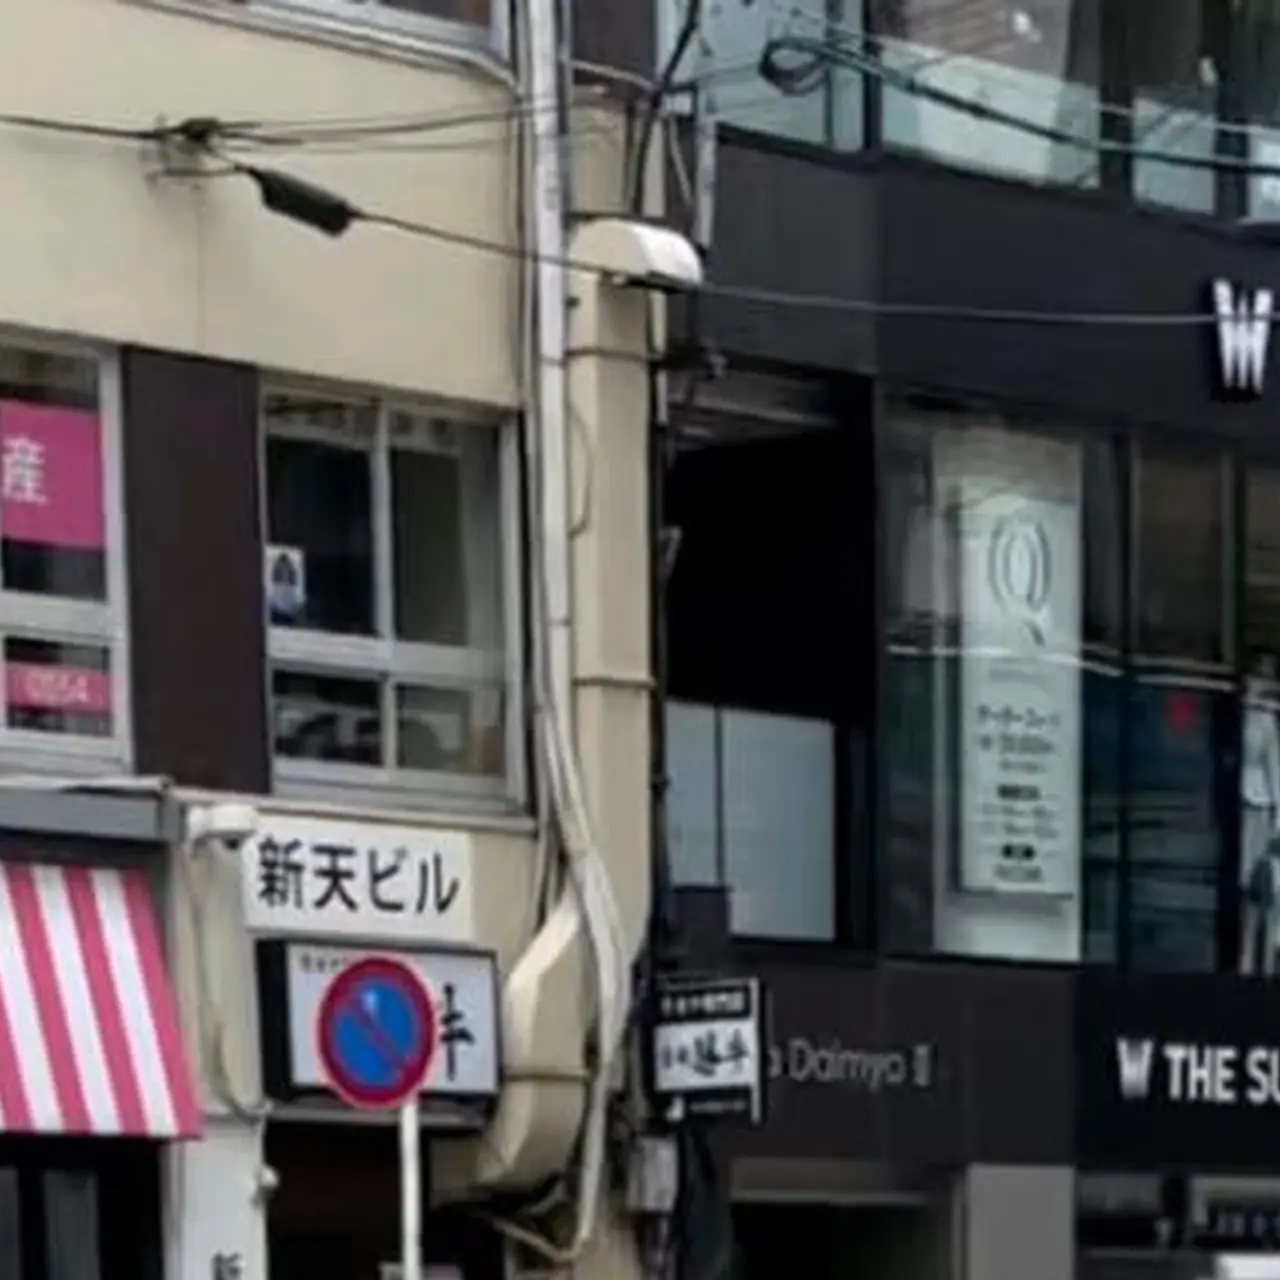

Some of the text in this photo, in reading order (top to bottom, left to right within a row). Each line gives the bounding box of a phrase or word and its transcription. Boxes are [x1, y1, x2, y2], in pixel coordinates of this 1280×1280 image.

[257, 836, 460, 917] 新天ビル
[788, 1037, 907, 1094] Daimyo
[1163, 1044, 1237, 1101] THE
